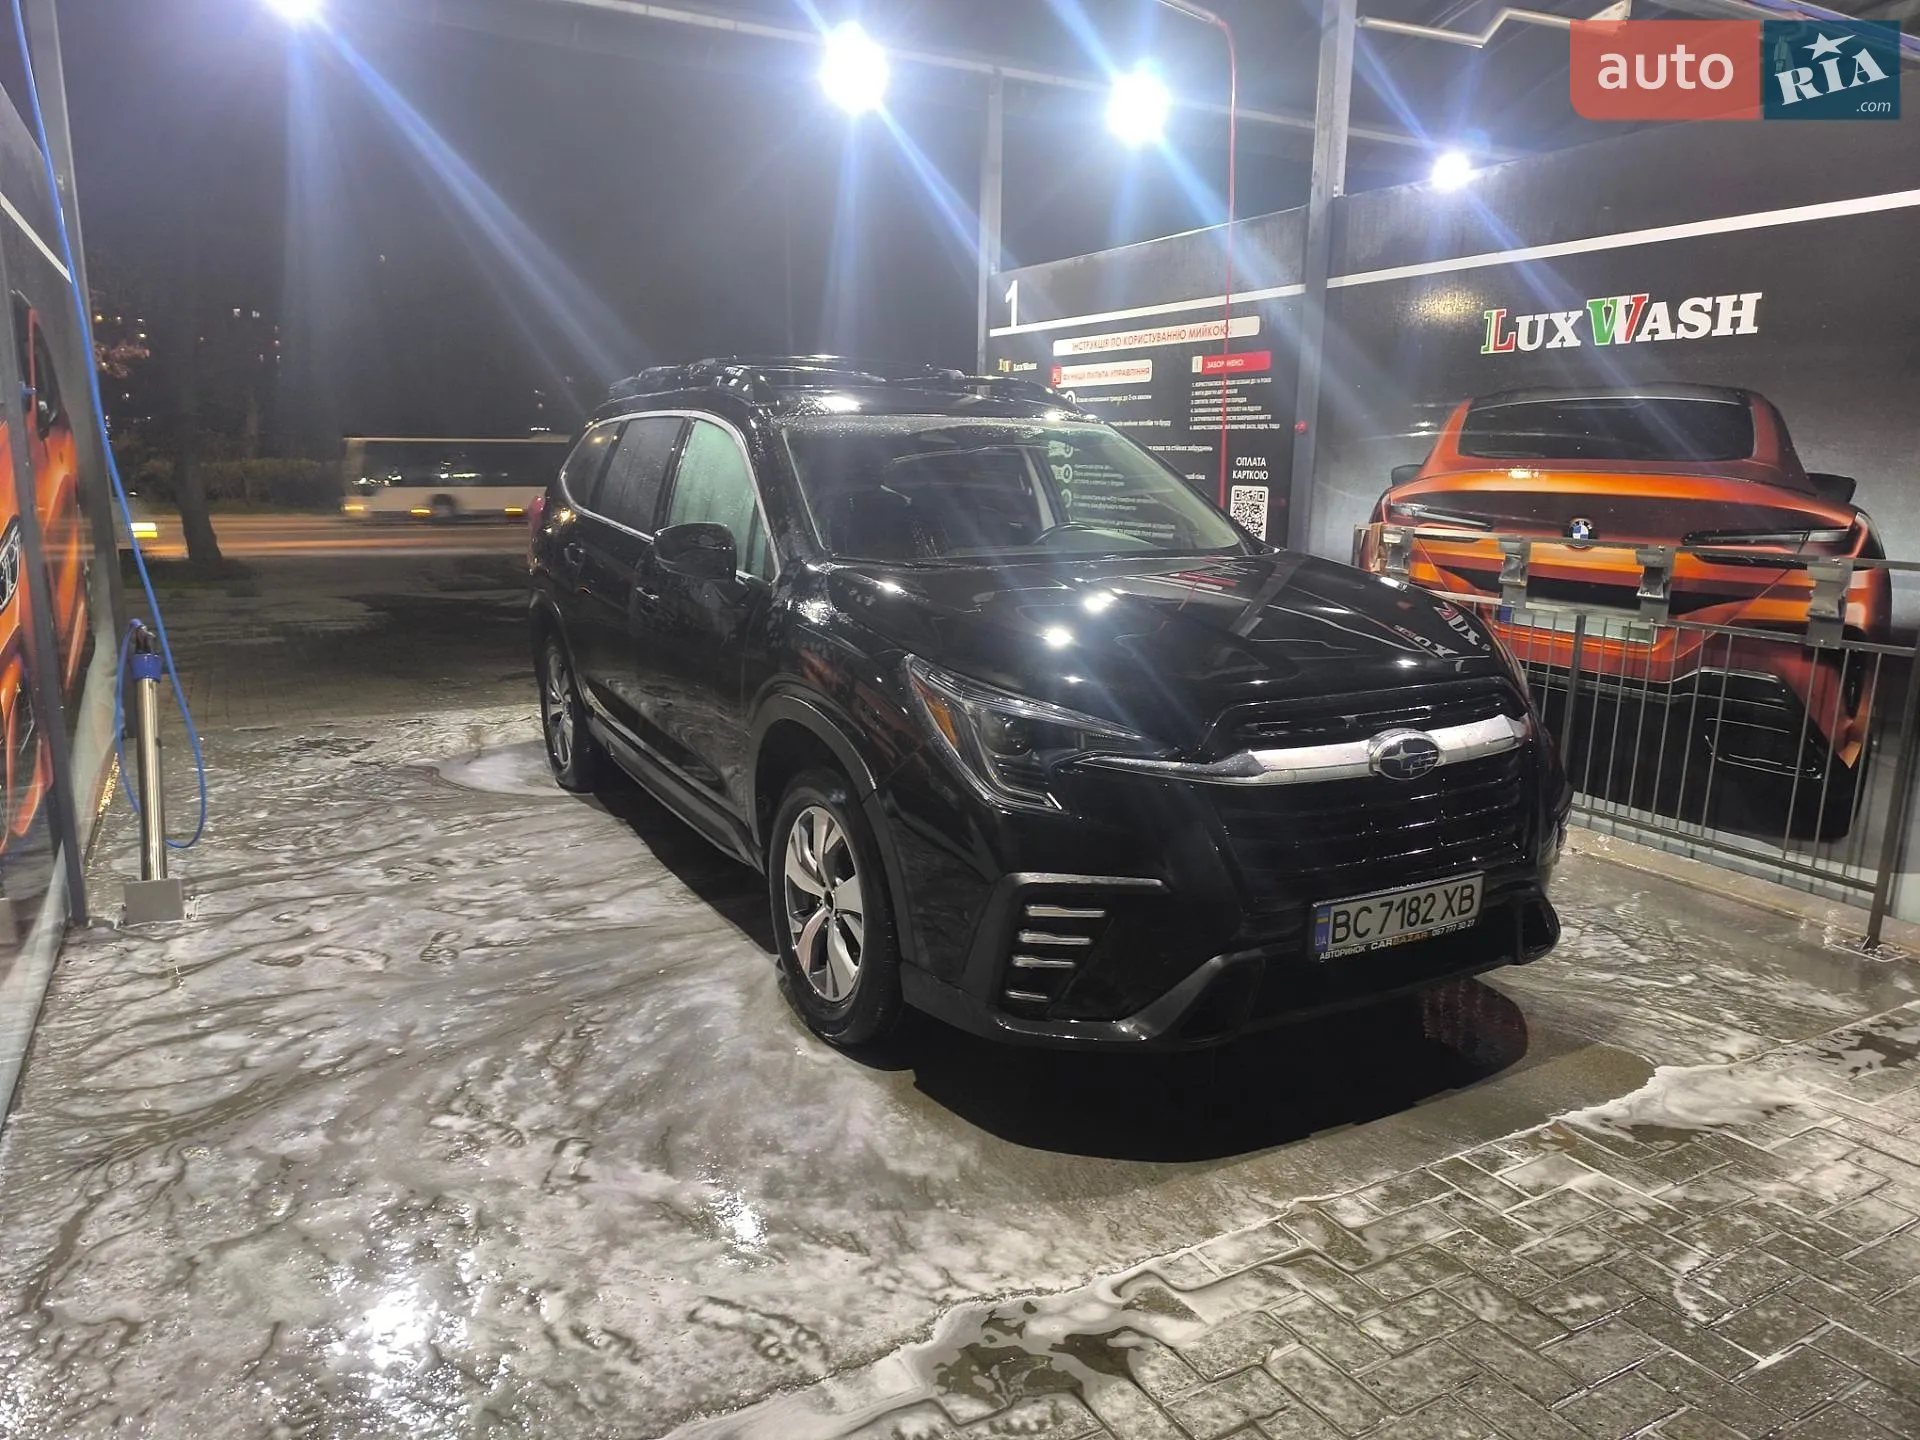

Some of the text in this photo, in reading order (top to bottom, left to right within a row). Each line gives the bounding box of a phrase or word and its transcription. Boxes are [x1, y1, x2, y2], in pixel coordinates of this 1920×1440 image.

[1005, 279, 1018, 327] 1
[1111, 338, 1122, 348] ПО
[1123, 328, 1186, 347] КОРИСТУВАННЮ
[1235, 457, 1267, 467] ОПЛАТА
[1232, 470, 1269, 480] КАРТКОЮ
[1379, 893, 1437, 934] 7182
[1315, 935, 1327, 947] UA
[1319, 944, 1366, 961] АВТОРИНОК
